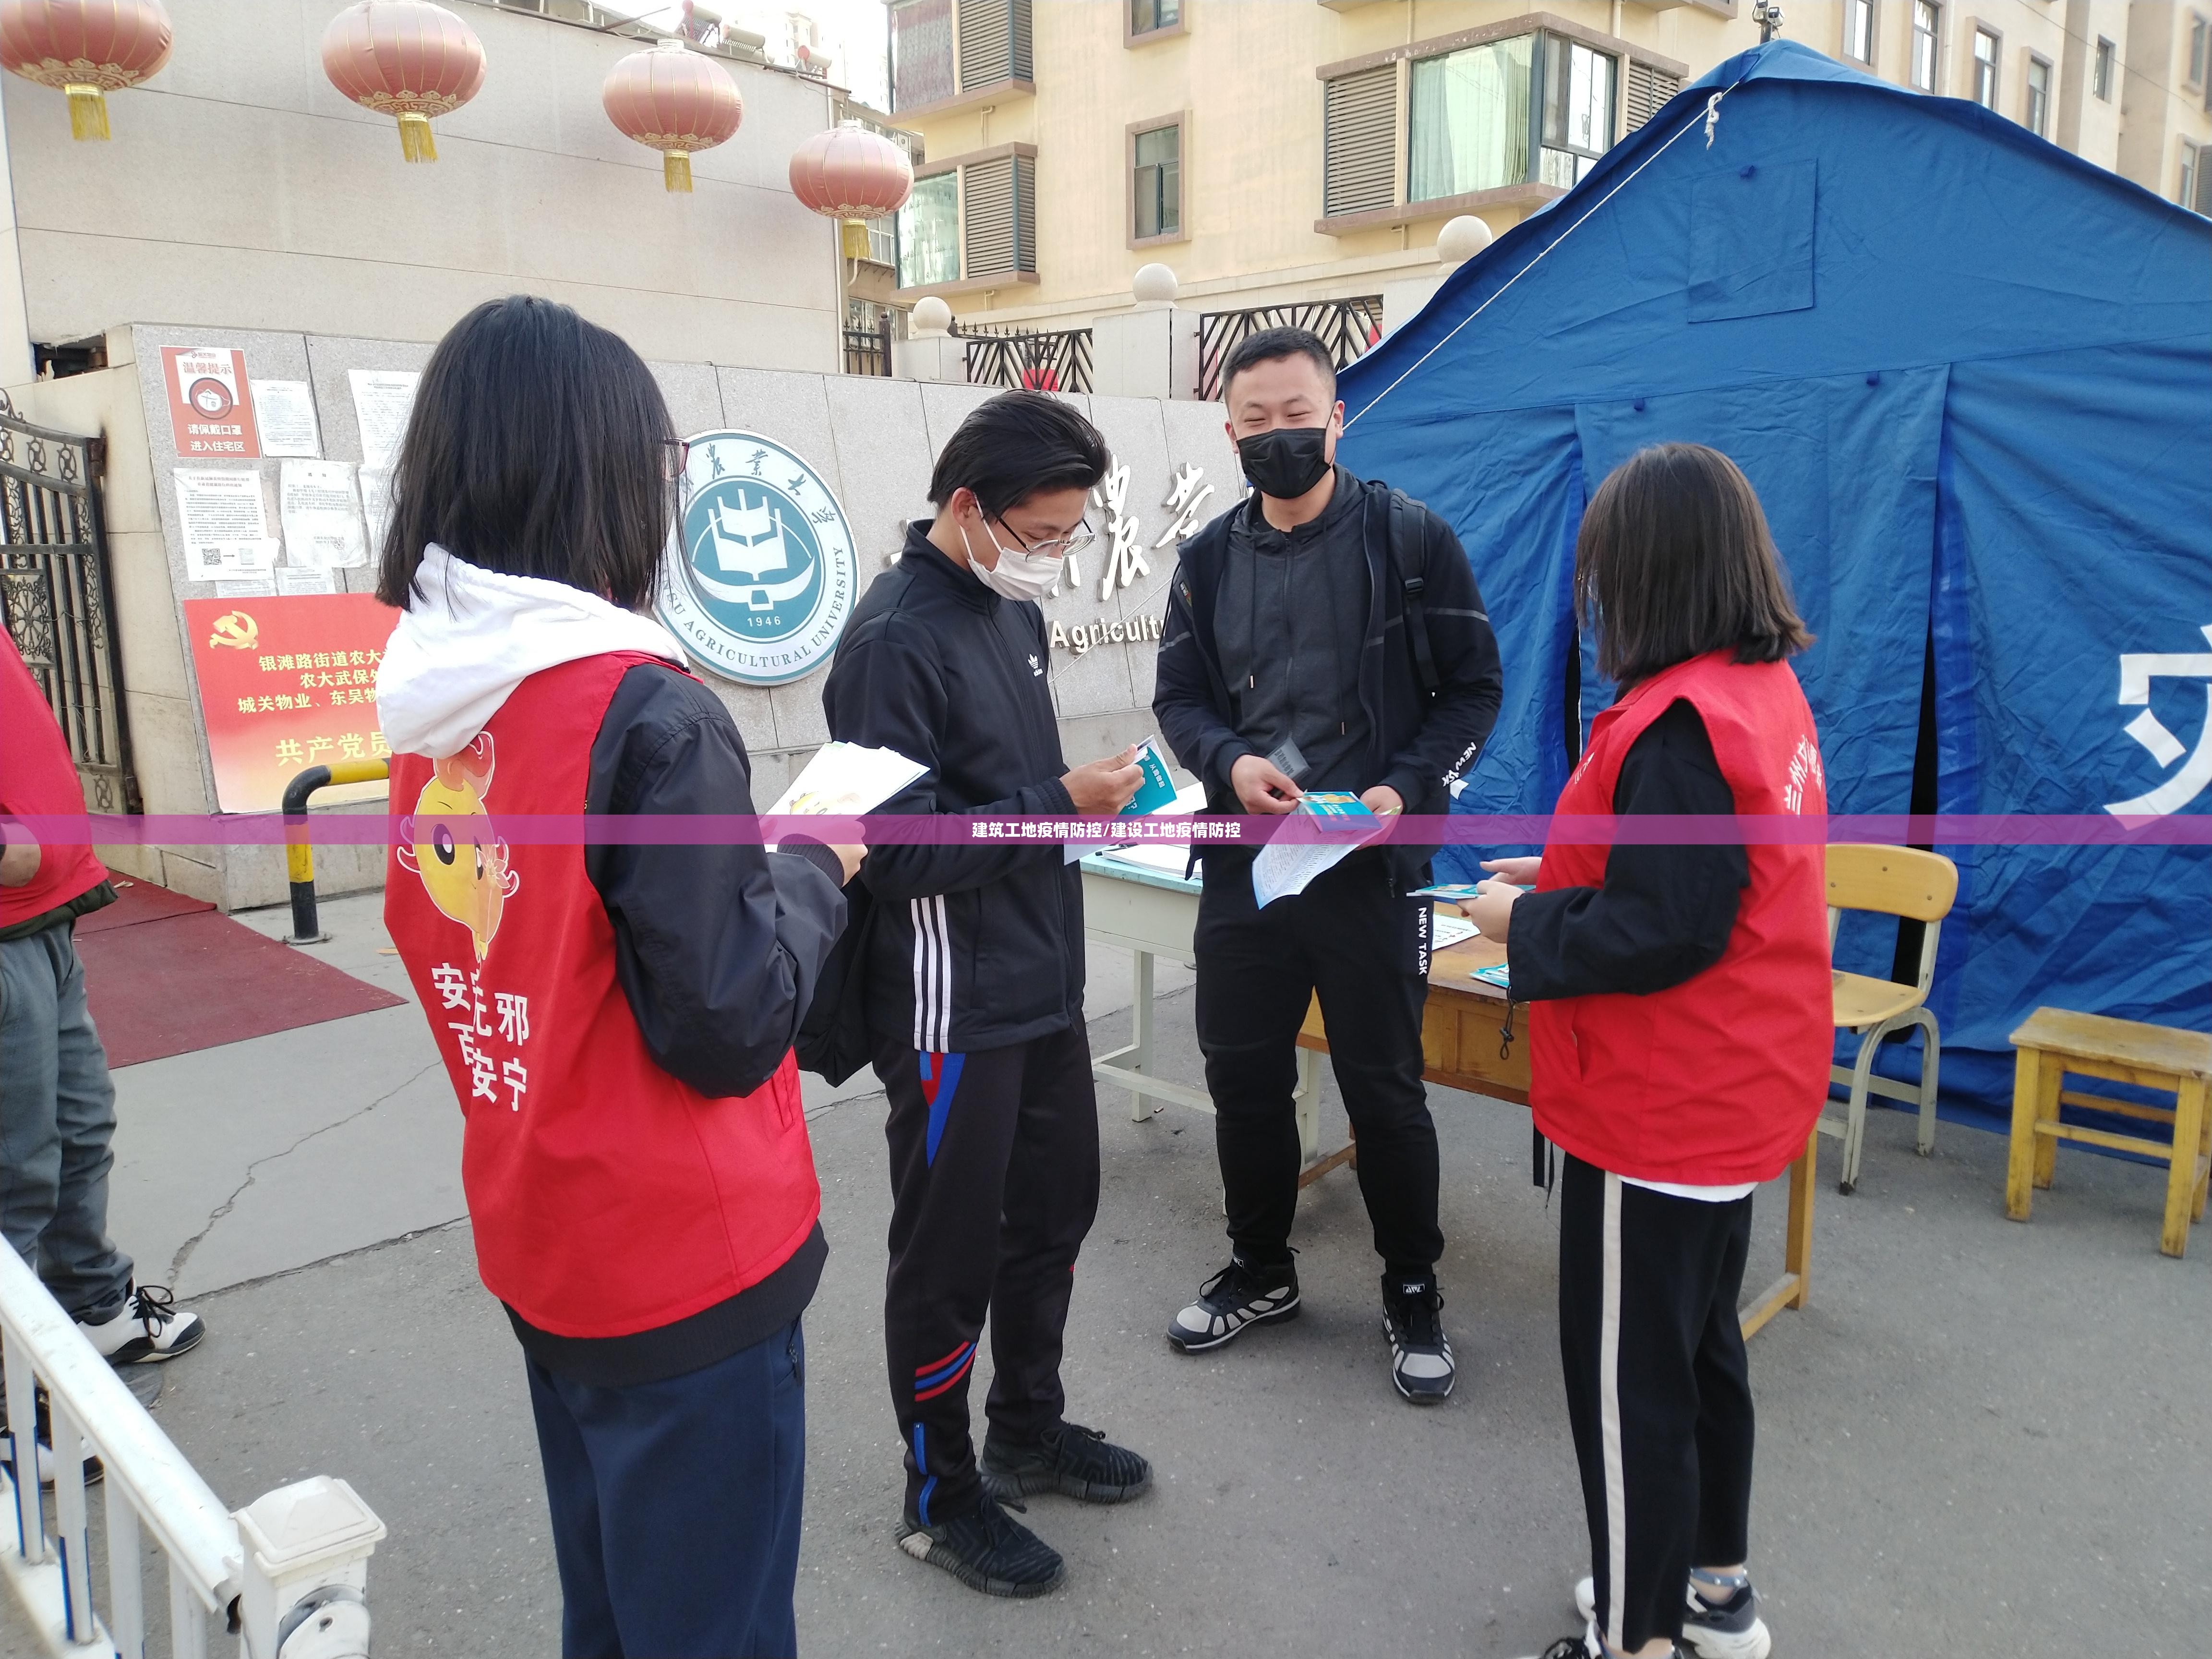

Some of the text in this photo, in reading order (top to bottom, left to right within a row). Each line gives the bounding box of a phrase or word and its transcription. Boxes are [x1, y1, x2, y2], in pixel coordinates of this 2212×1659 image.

[183, 362, 231, 374] 温馨提示
[188, 424, 242, 436] 请佩戴口罩
[190, 441, 245, 453] 进入住宅区
[684, 621, 811, 668] AGRICULTURAL
[811, 547, 846, 647] UNIVERSITY
[747, 616, 781, 627] 1946
[1050, 614, 1164, 653] Agricult
[258, 648, 387, 672] 银滩路街道农大
[276, 731, 393, 767] 共产党员
[1455, 742, 1477, 770] NEW
[1419, 907, 1428, 975] NEW TASK
